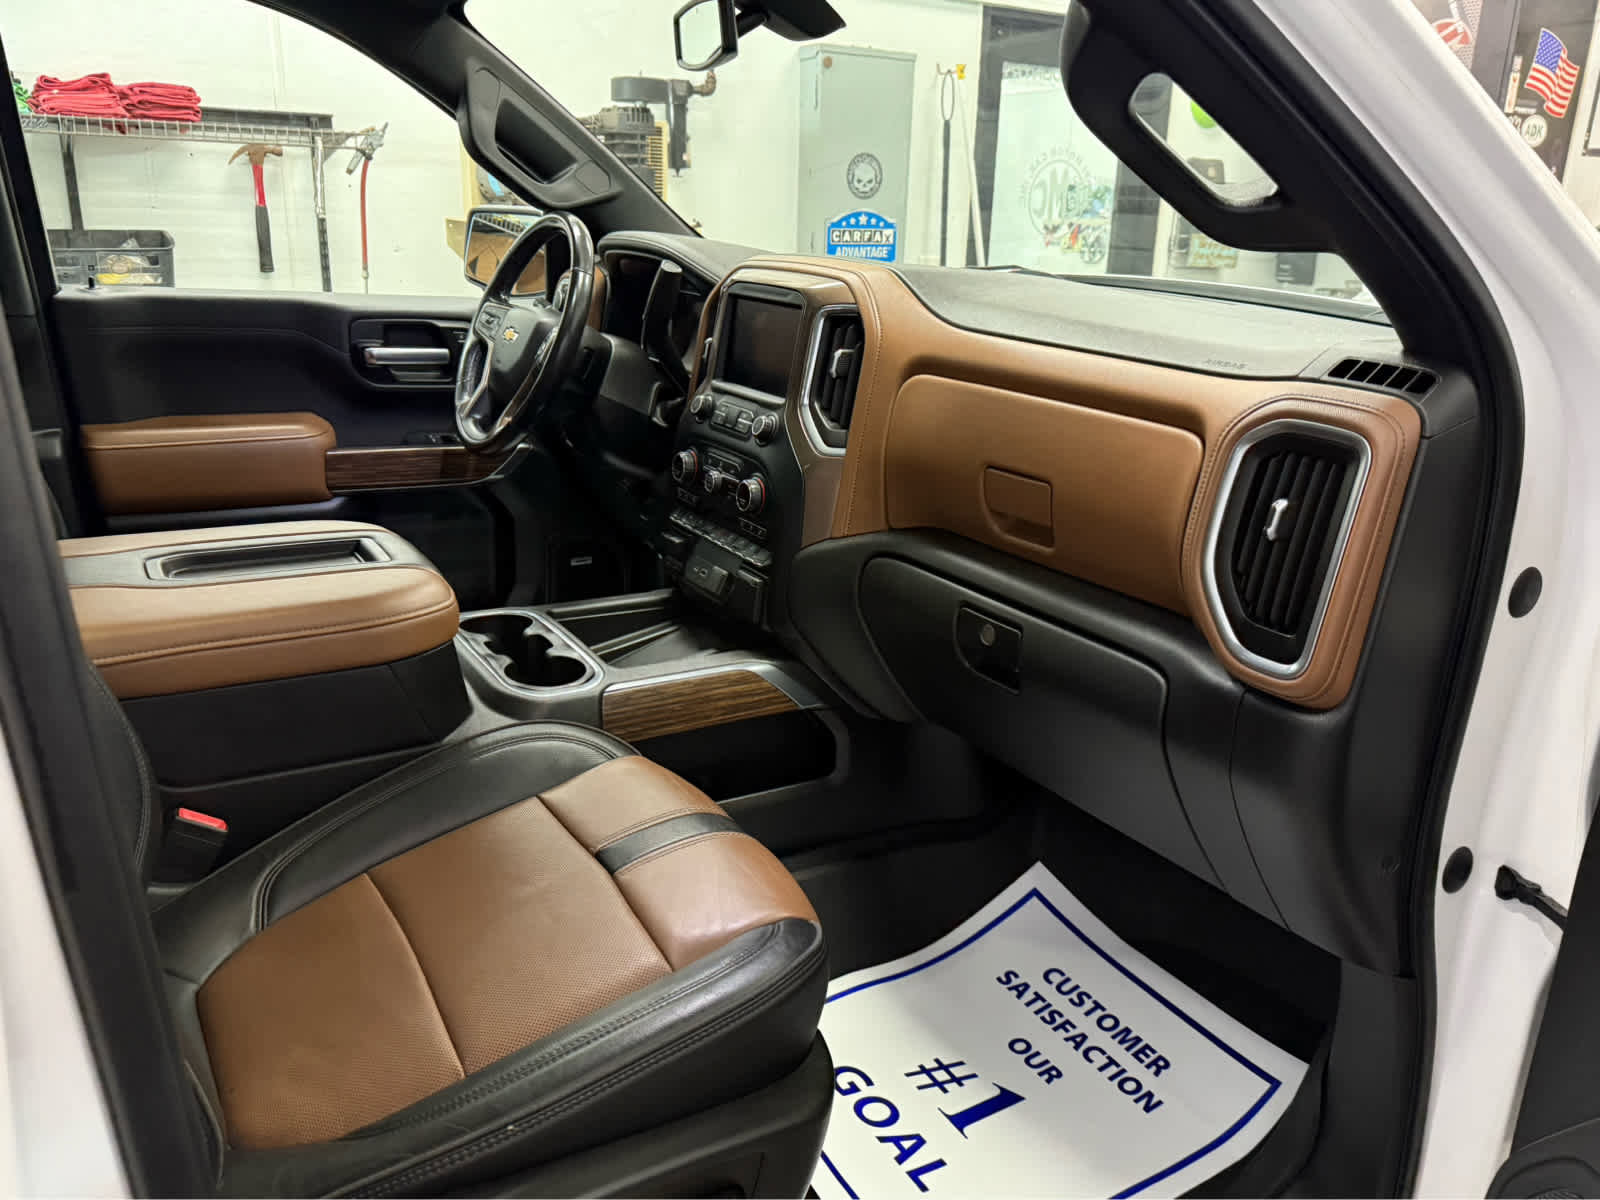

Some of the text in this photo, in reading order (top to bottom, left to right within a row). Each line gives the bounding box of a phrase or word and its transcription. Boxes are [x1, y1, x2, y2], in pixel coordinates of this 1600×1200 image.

[1525, 122, 1544, 137] ADK
[831, 229, 894, 243] CARFAX
[835, 245, 889, 258] ADVANTAGE
[996, 969, 1164, 1115] SATISFACTION
[1042, 967, 1172, 1078] CUSTOMER
[1007, 1037, 1064, 1085] OUR
[834, 1066, 948, 1193] GOAL
[904, 1057, 1026, 1140] #1
